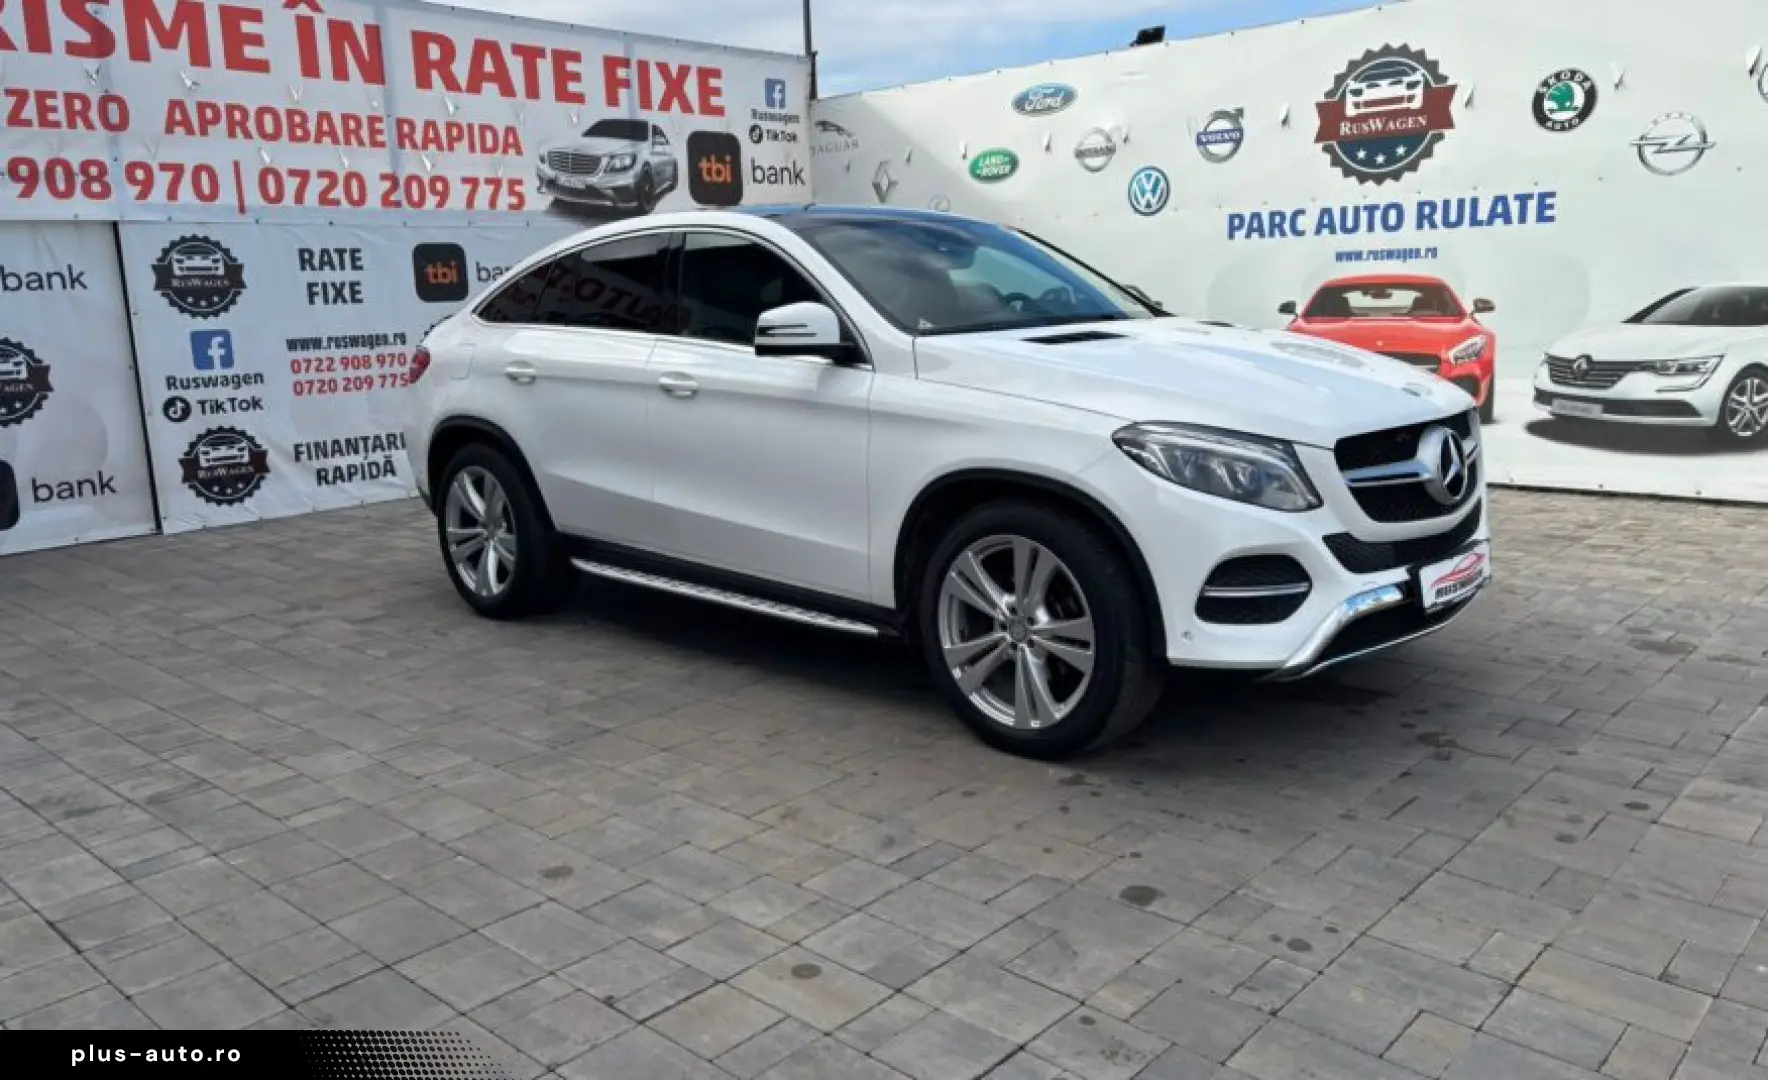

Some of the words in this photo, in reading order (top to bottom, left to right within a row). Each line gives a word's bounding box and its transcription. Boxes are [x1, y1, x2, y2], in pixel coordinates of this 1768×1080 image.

[0, 0, 270, 74] ISME
[283, 0, 387, 86] ÎN
[411, 29, 586, 106] RATE
[602, 54, 726, 118] FIXE
[1024, 86, 1065, 111] Ford
[4, 88, 131, 132] ZERO
[164, 99, 387, 149] APROBARE
[396, 117, 524, 156] RAPIDA
[1199, 130, 1241, 144] VOLVO
[698, 154, 733, 184] tbi
[751, 157, 806, 186] bank
[6, 157, 112, 201] 908
[125, 163, 220, 204] 970
[257, 166, 367, 208] 0720
[379, 173, 451, 210] 209
[460, 176, 526, 211] 775
[1227, 207, 1307, 241] PARC
[1313, 201, 1405, 236] AUTO
[1415, 191, 1556, 230] RULATE
[297, 247, 365, 273] RATE
[1335, 246, 1438, 263] www.ruswagen.ro
[0, 263, 88, 292] bank
[423, 260, 458, 285] tbi
[475, 260, 513, 284] ba
[306, 280, 365, 306] FIXE
[285, 330, 407, 352] www.ruswagen.ro
[290, 356, 336, 375] 0722
[340, 354, 372, 371] 908
[376, 352, 407, 369] 970
[165, 372, 265, 392] Ruswagen
[292, 377, 338, 397] 0720
[342, 374, 374, 393] 209
[377, 372, 411, 389] 775
[198, 396, 264, 416] TikTok
[316, 453, 397, 487] RAPIDĂ
[31, 470, 118, 504] bank
